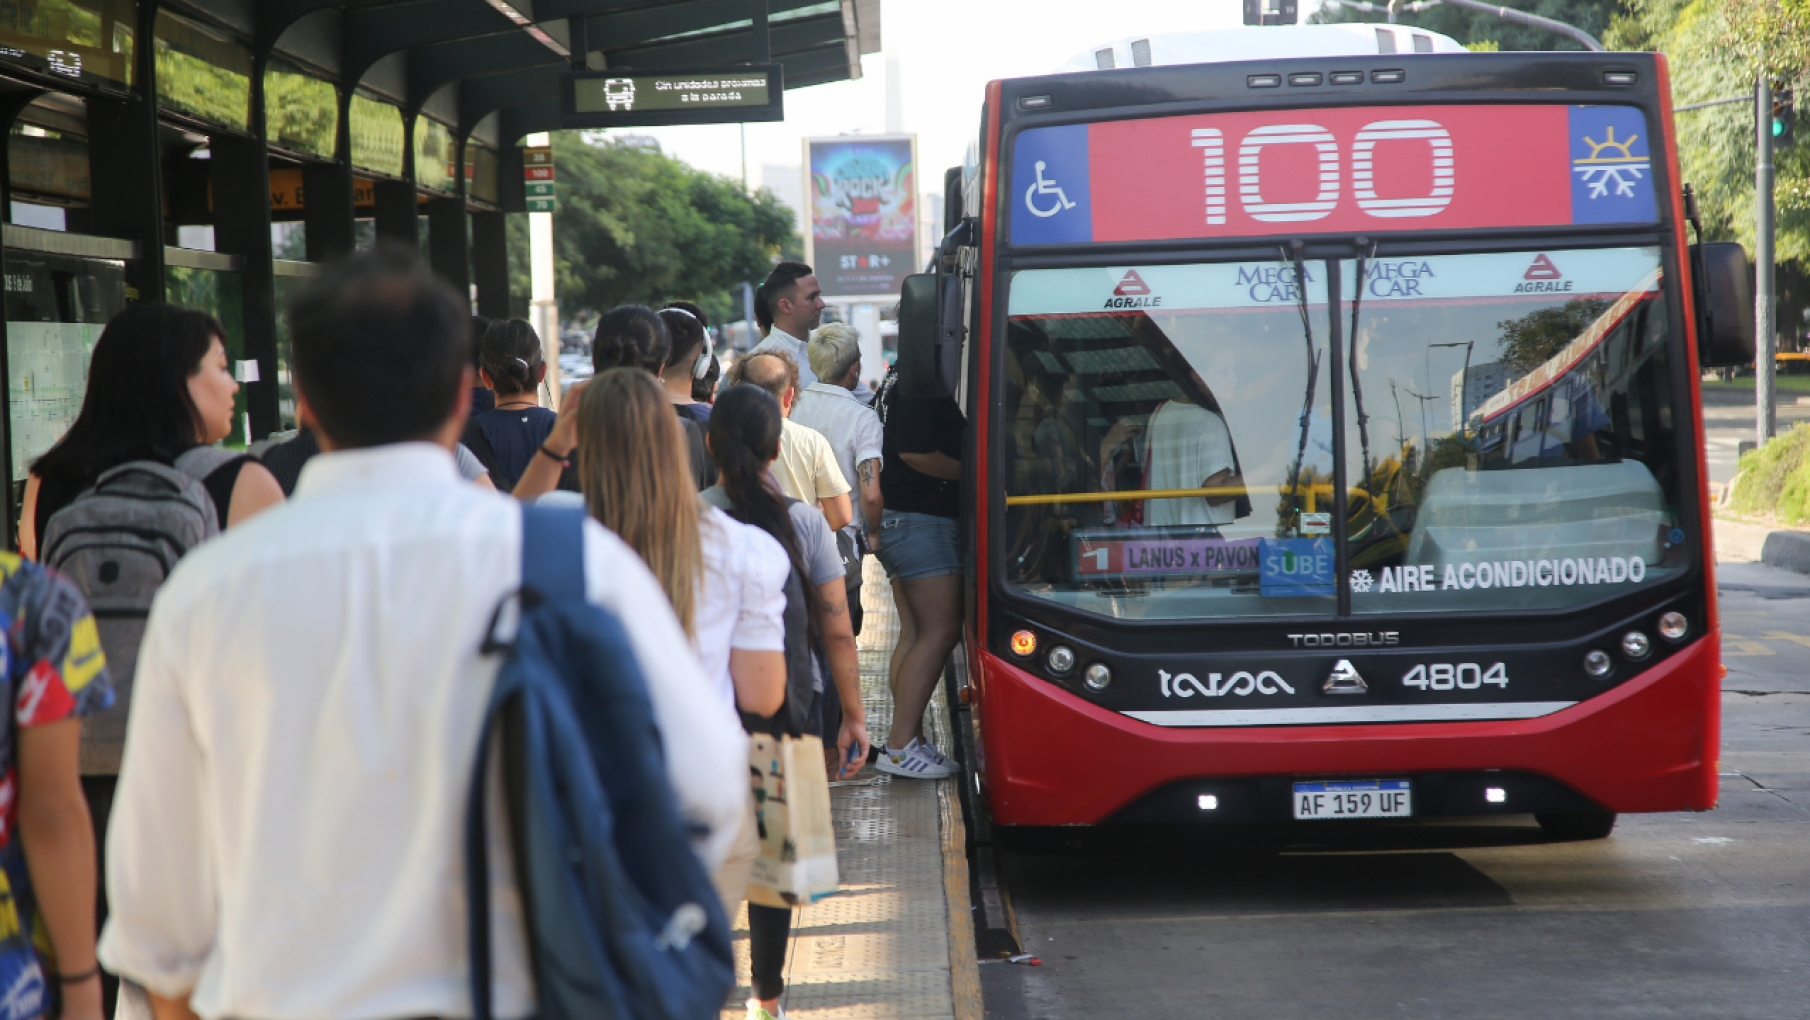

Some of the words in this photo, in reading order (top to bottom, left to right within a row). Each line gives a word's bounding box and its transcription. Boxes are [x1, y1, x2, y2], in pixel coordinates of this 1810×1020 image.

[702, 92, 742, 102] parada
[532, 169, 549, 178] 100
[1190, 119, 1454, 225] 100
[1250, 282, 1300, 302] CAR
[1370, 277, 1423, 297] CAR
[1514, 281, 1573, 293] AGRALE
[1103, 296, 1162, 309] AGRALE
[1082, 547, 1109, 570] 1
[1129, 546, 1185, 569] LANUS
[1205, 545, 1260, 567] PAVON
[1266, 553, 1329, 575] SUBE
[1379, 564, 1436, 593] AIRE
[1442, 555, 1646, 591] ACONDICIONADO
[1287, 631, 1400, 647] TODOBUS
[1402, 662, 1509, 691] 4804
[1300, 794, 1325, 816] AF
[1333, 792, 1373, 814] 159
[1380, 792, 1406, 813] UF
